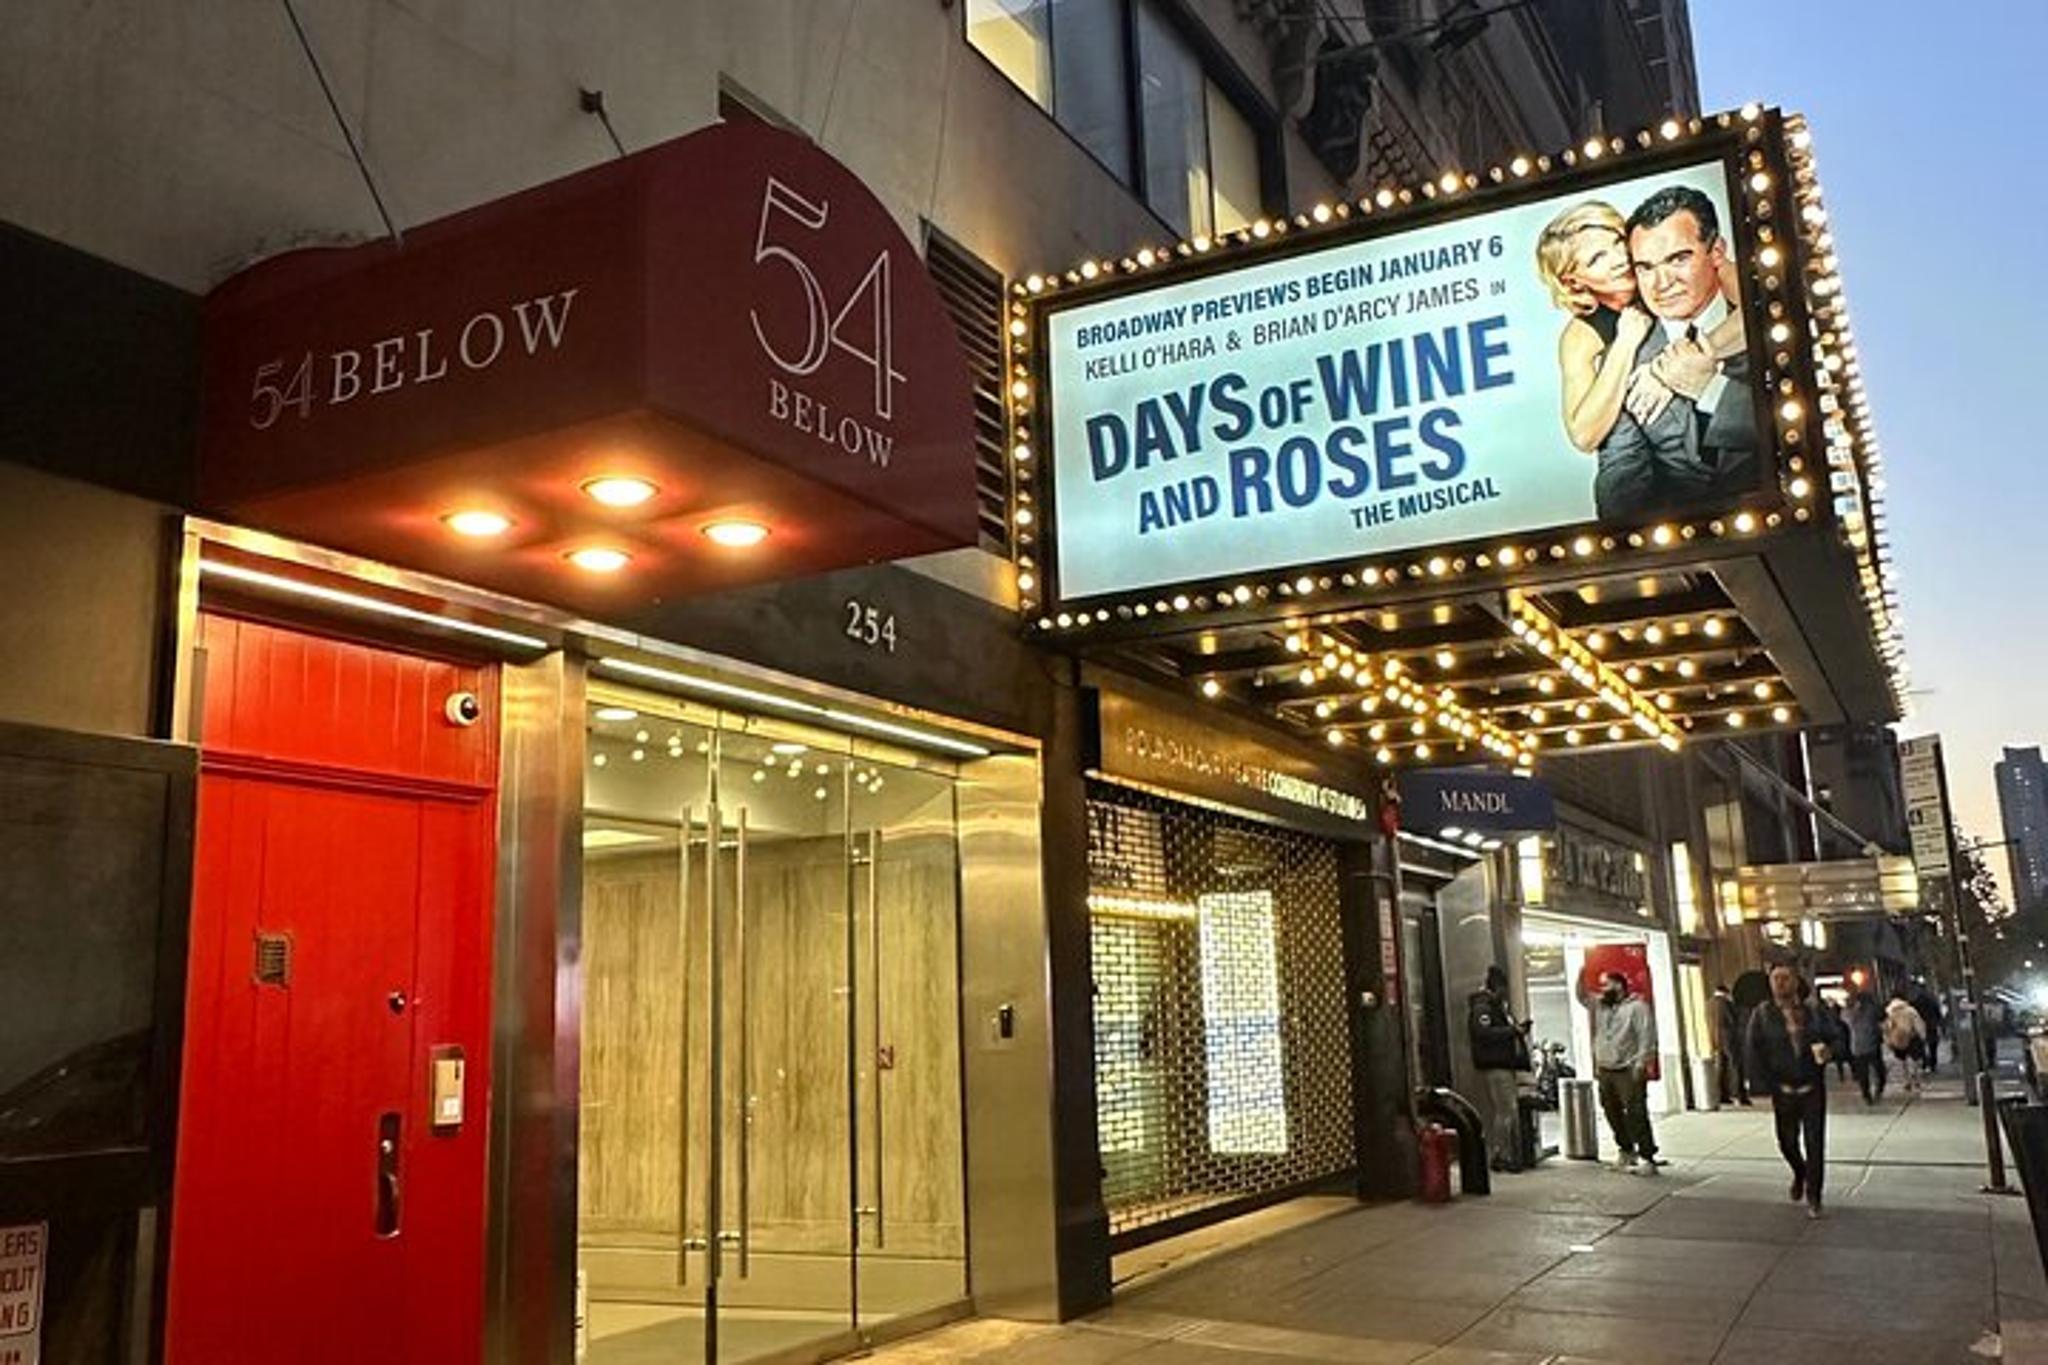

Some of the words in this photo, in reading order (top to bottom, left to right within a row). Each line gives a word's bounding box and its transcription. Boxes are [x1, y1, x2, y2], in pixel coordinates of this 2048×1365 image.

[750, 176, 907, 420] 54
[1077, 306, 1187, 348] BROADWAY
[1191, 280, 1301, 324] PREVIEWS
[1306, 263, 1373, 299] BEGIN
[1379, 238, 1483, 283] JANUARY
[1489, 235, 1503, 257] 6
[1085, 353, 1137, 380] KELLI
[1143, 334, 1216, 368] O'HARA
[1226, 330, 1241, 351] &
[1254, 312, 1318, 345] BRIAN
[1324, 295, 1400, 331] D'ARCY
[1405, 278, 1480, 314] JAMES
[1490, 279, 1506, 296] IN
[249, 350, 317, 430] 54
[328, 288, 580, 405] BELOW
[1085, 372, 1254, 482] DAYS
[1260, 379, 1314, 430] OF
[1317, 314, 1515, 422] WINE
[769, 378, 896, 469] BELOW
[1139, 475, 1221, 534] AND
[1229, 407, 1467, 518] ROSES
[1350, 500, 1394, 530] THE
[1398, 477, 1500, 520] MUSICAL
[845, 599, 898, 653] 254
[1438, 790, 1514, 814] MANDL
